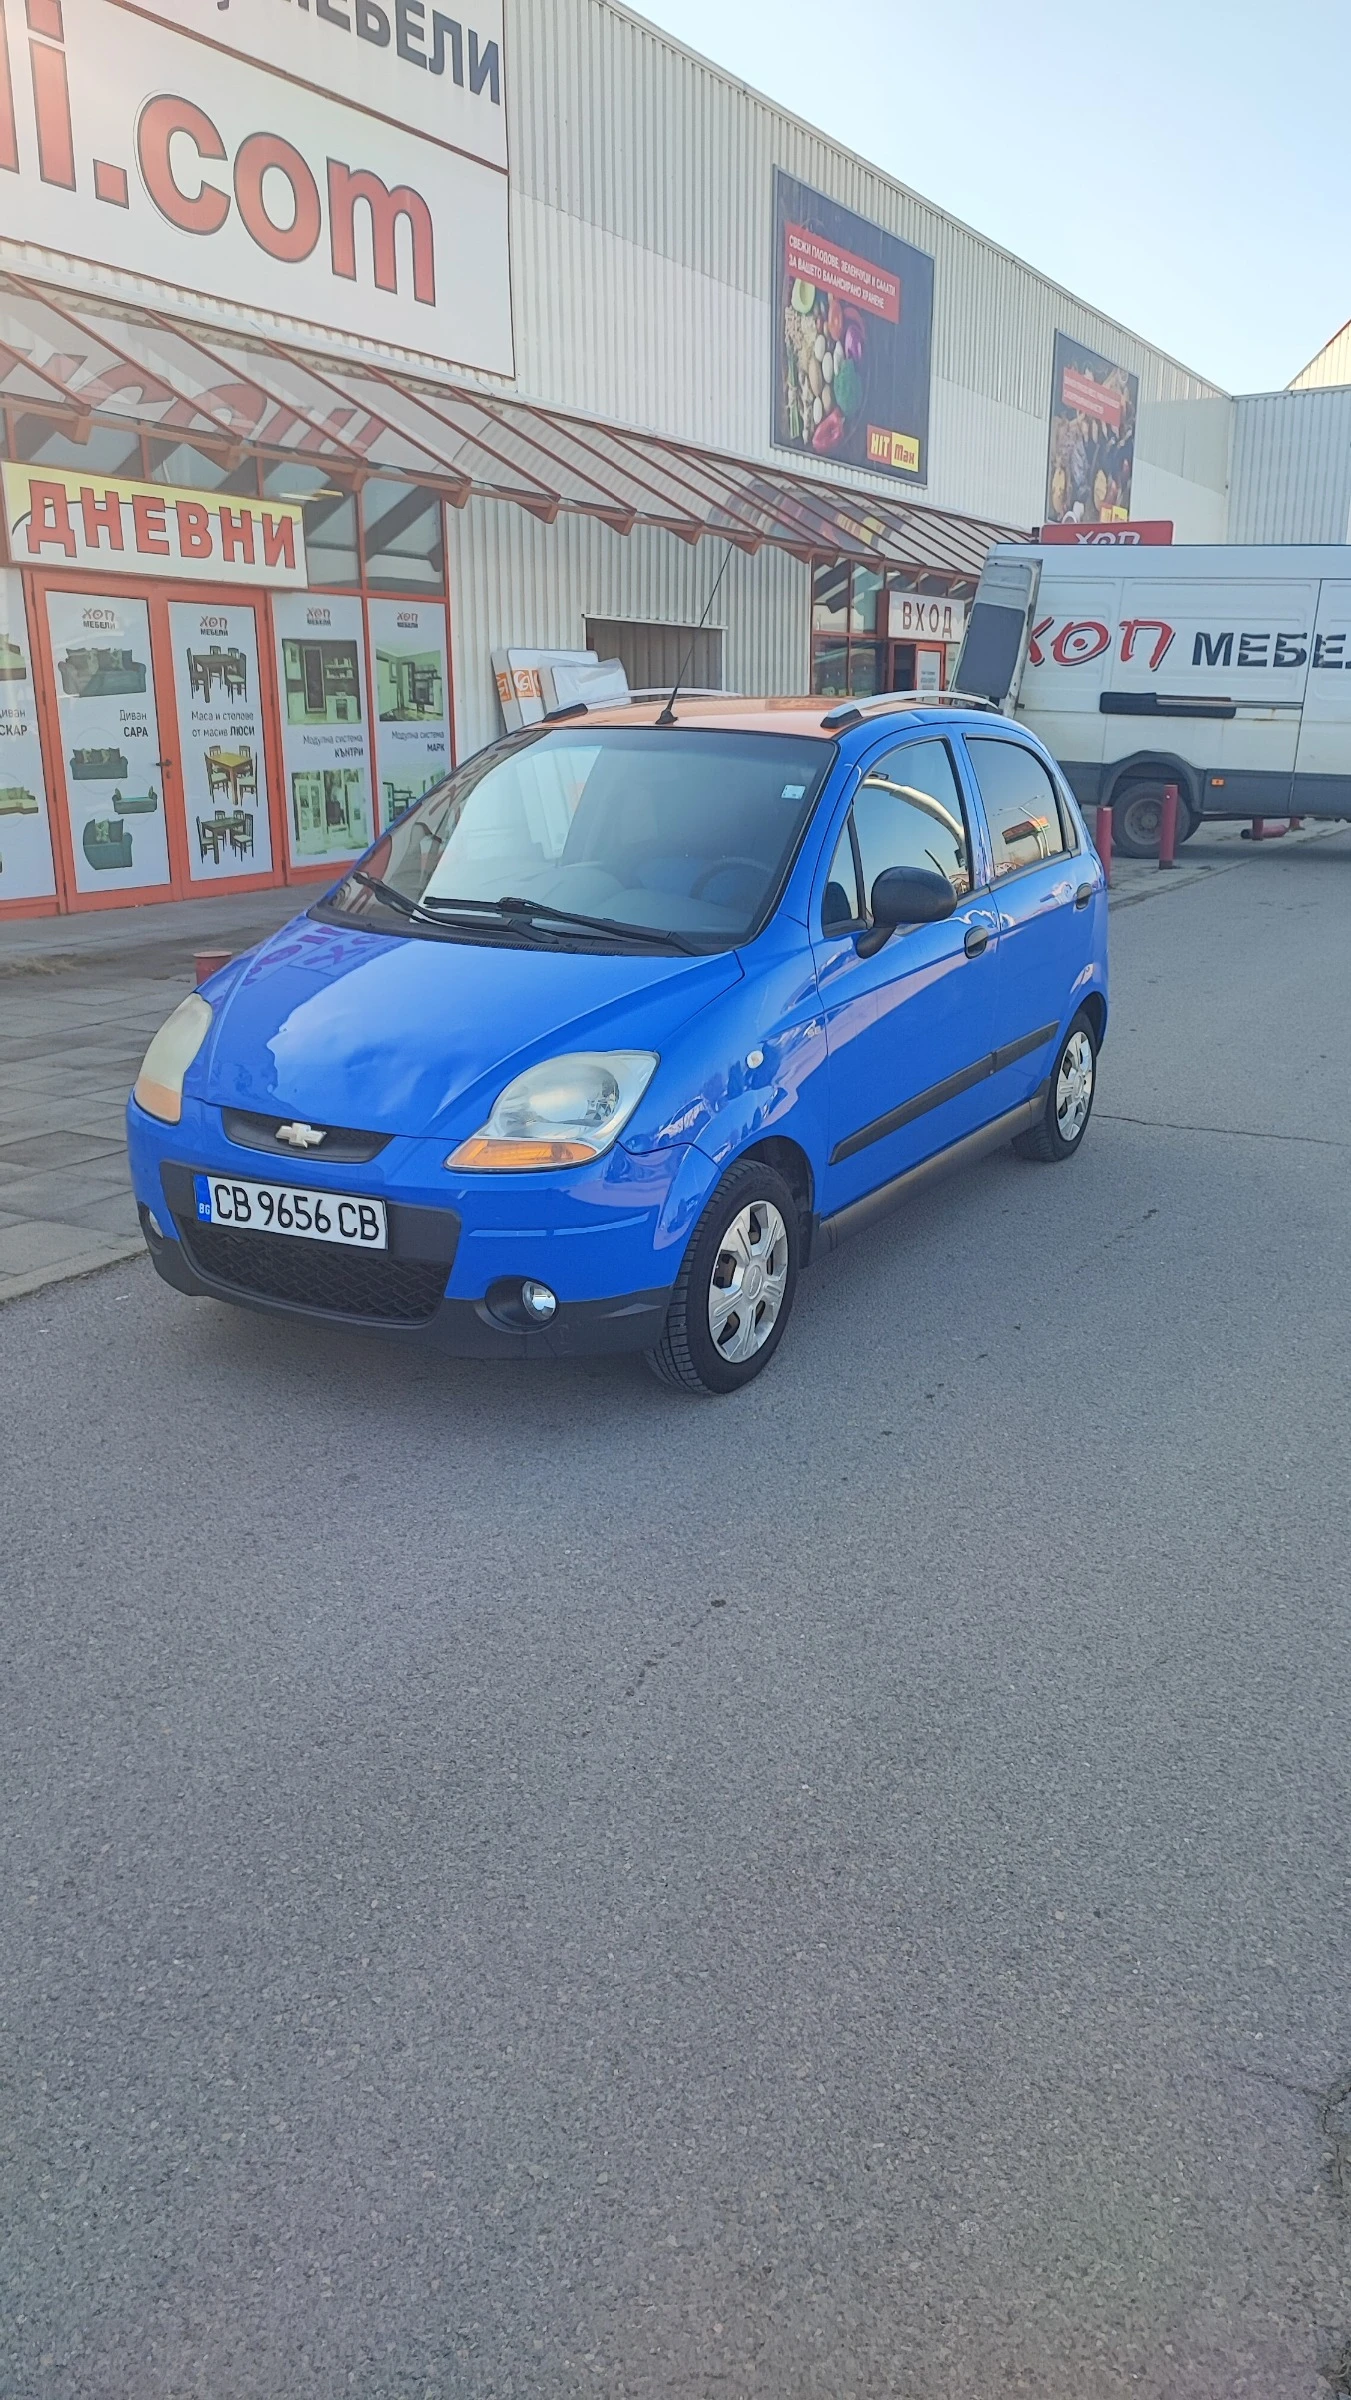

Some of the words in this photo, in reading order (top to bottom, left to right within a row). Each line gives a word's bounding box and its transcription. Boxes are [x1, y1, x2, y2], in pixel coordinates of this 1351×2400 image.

[280, 0, 500, 106] БЕЛИ
[789, 235, 811, 255] СВЕЖИ
[789, 254, 797, 268] ЗА
[798, 258, 822, 279] ВАШЕТО
[871, 432, 890, 458] HIT
[25, 478, 297, 570] ДНЕВНИ
[82, 608, 115, 622] ХОП
[200, 615, 228, 629] ХОП
[903, 601, 952, 639] ВХОД
[83, 620, 116, 630] МЕБЕЛИ
[200, 628, 229, 637] МЕБЕЛИ
[1192, 631, 1351, 669] МЕБЕ
[0, 708, 26, 719] иван
[119, 709, 147, 722] Диван
[191, 710, 213, 720] Маса
[123, 726, 149, 738] САРА
[192, 729, 200, 737] от
[203, 728, 228, 737] масив
[427, 743, 445, 752] МАРК
[199, 1202, 210, 1215] BG
[214, 1184, 251, 1222] CB
[257, 1191, 332, 1234] 9656
[338, 1202, 379, 1241] CB
